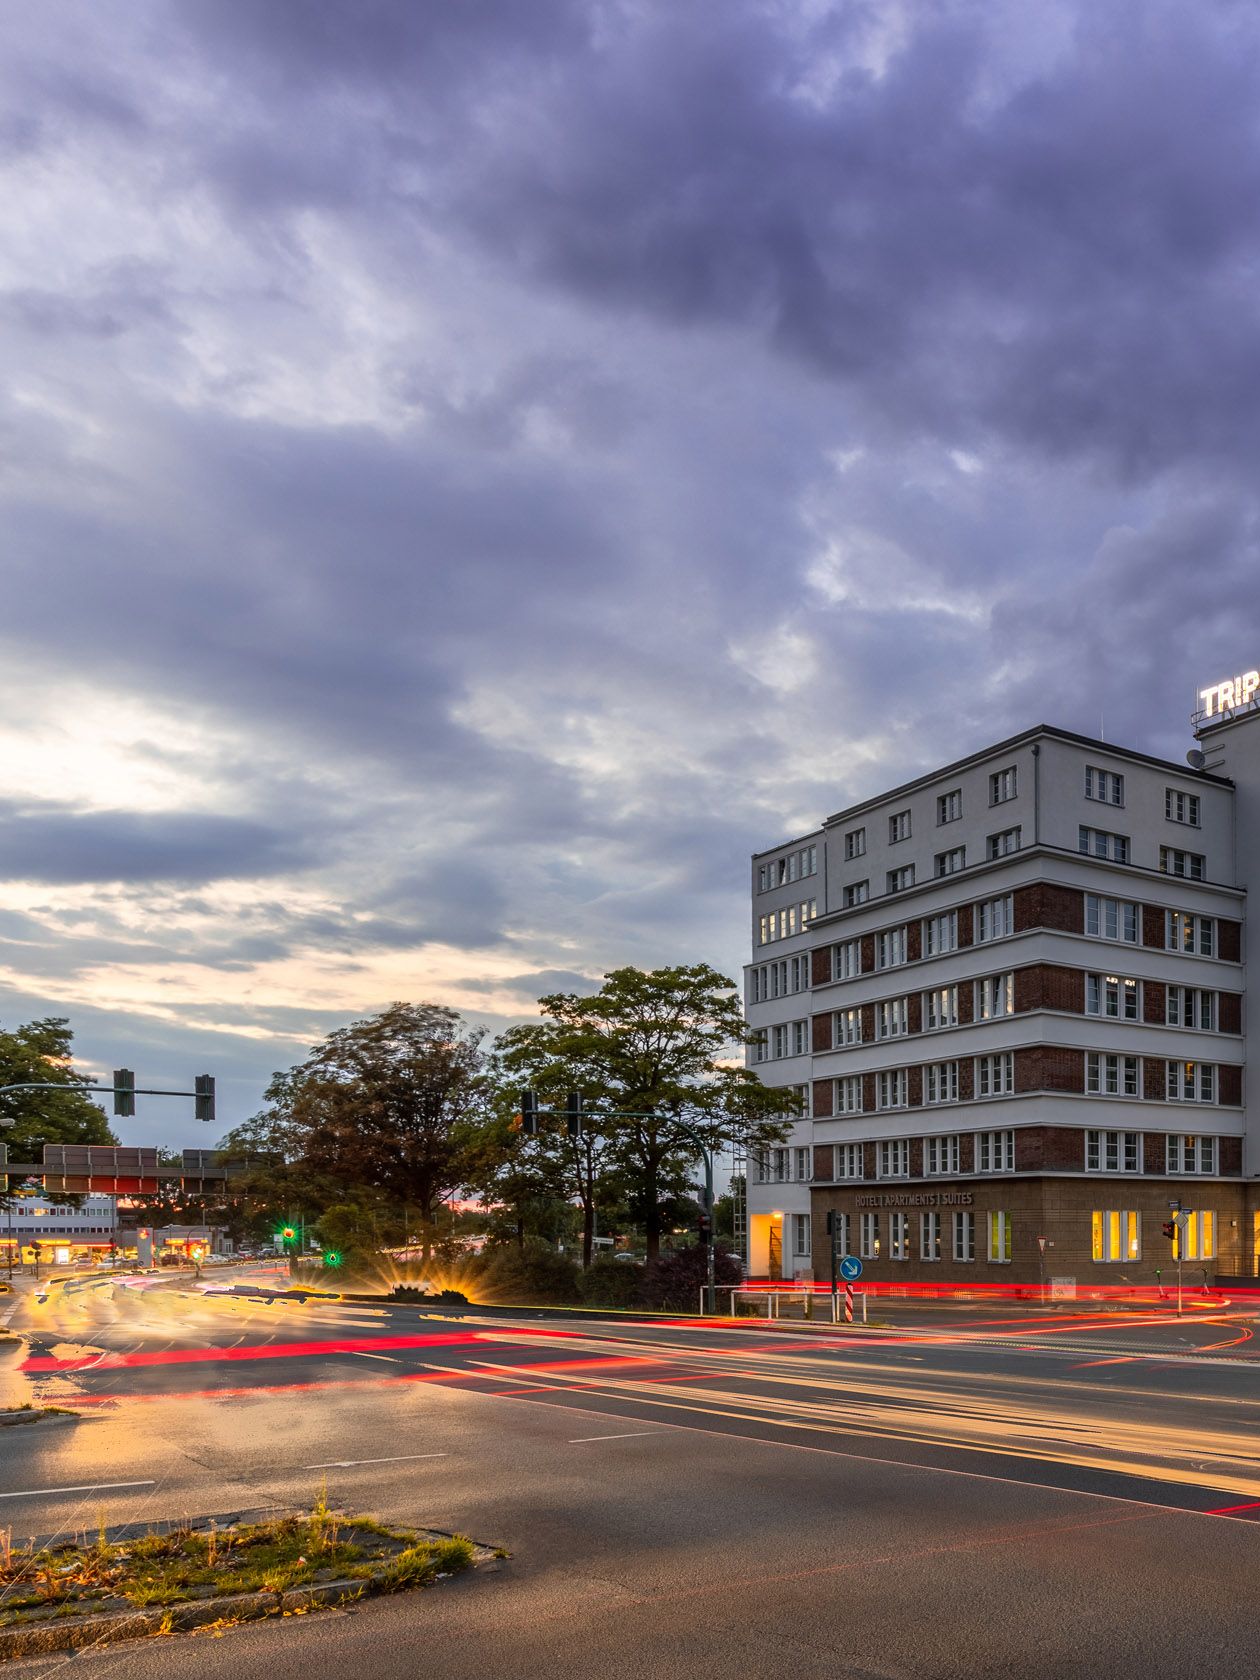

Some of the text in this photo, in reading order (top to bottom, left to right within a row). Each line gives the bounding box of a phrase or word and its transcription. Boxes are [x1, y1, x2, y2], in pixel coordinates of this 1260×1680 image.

[856, 1192, 973, 1207] HOTEL APARTMENTS SUITES
